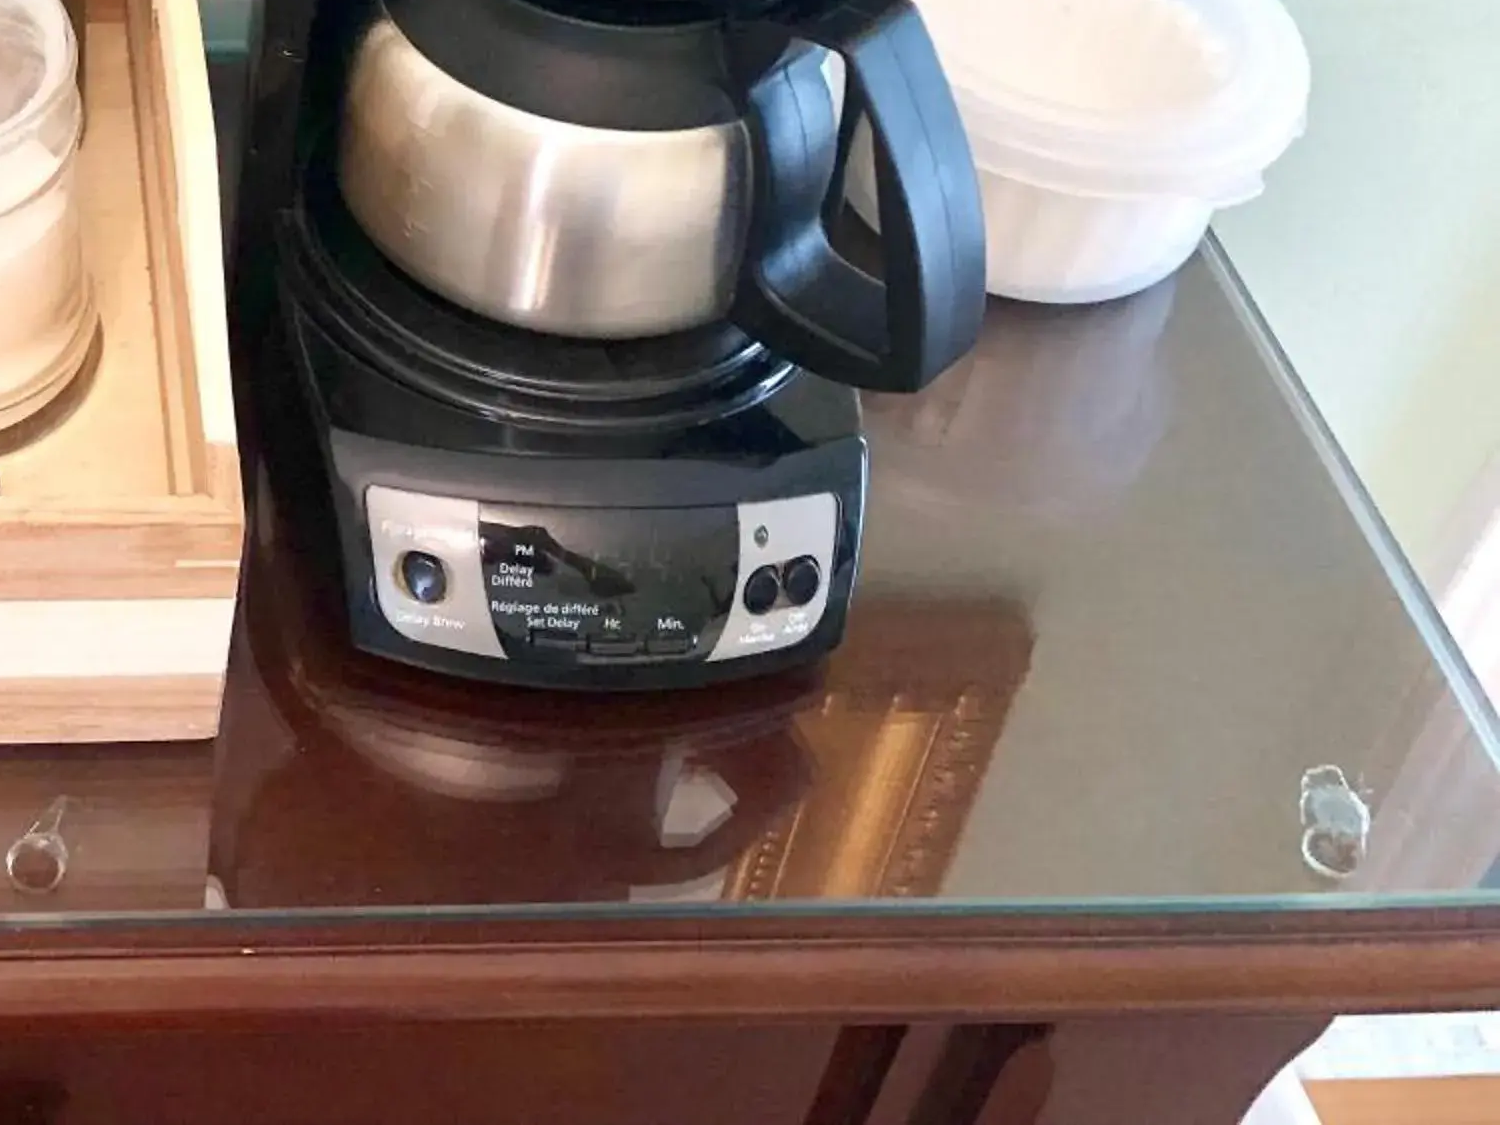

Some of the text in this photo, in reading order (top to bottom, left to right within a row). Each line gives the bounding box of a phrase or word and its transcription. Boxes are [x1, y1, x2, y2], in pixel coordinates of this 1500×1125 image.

[515, 544, 534, 556] PM
[499, 563, 534, 577] Delay
[491, 601, 540, 614] Réglage
[526, 616, 580, 630] Set Delay
